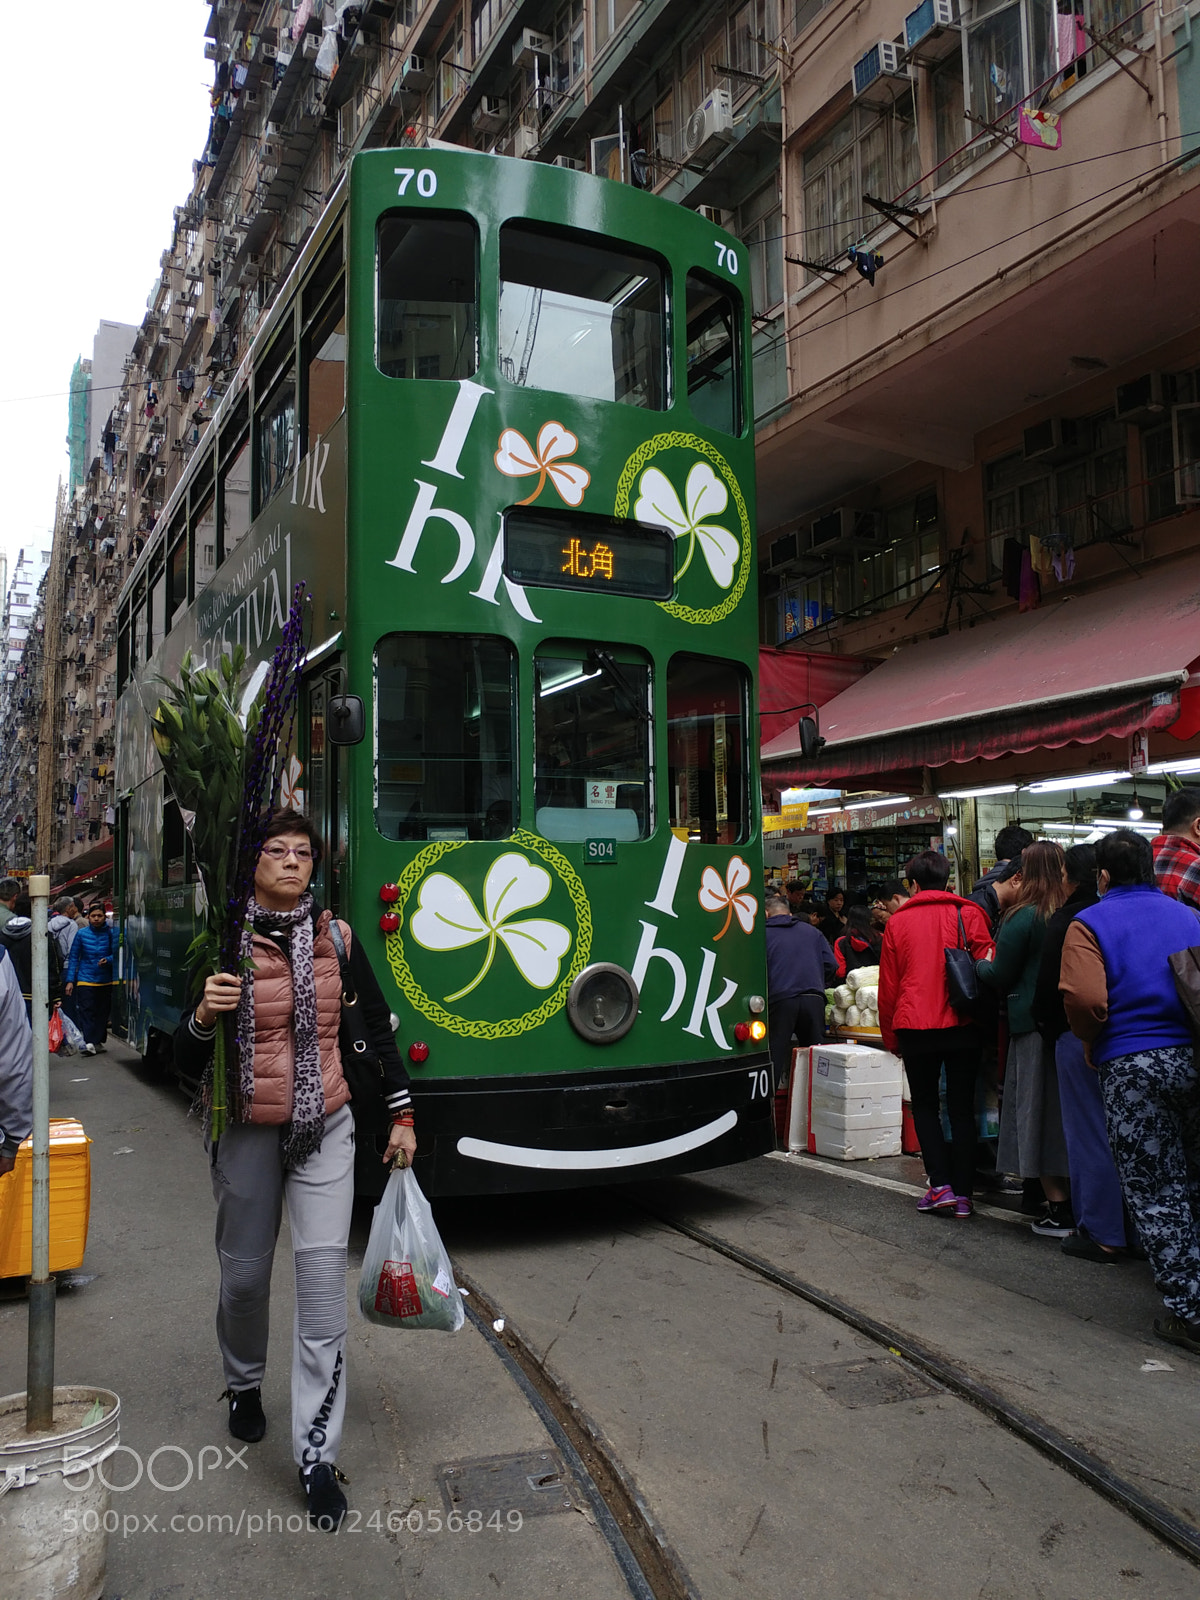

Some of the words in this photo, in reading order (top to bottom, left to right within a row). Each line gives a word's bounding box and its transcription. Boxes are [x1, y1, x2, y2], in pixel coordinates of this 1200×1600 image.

[394, 168, 438, 198] 70
[713, 241, 738, 276] 70
[562, 539, 614, 580] 北角
[588, 842, 614, 857] S04
[748, 1069, 769, 1100] 70
[301, 1349, 343, 1465] COMBAT
